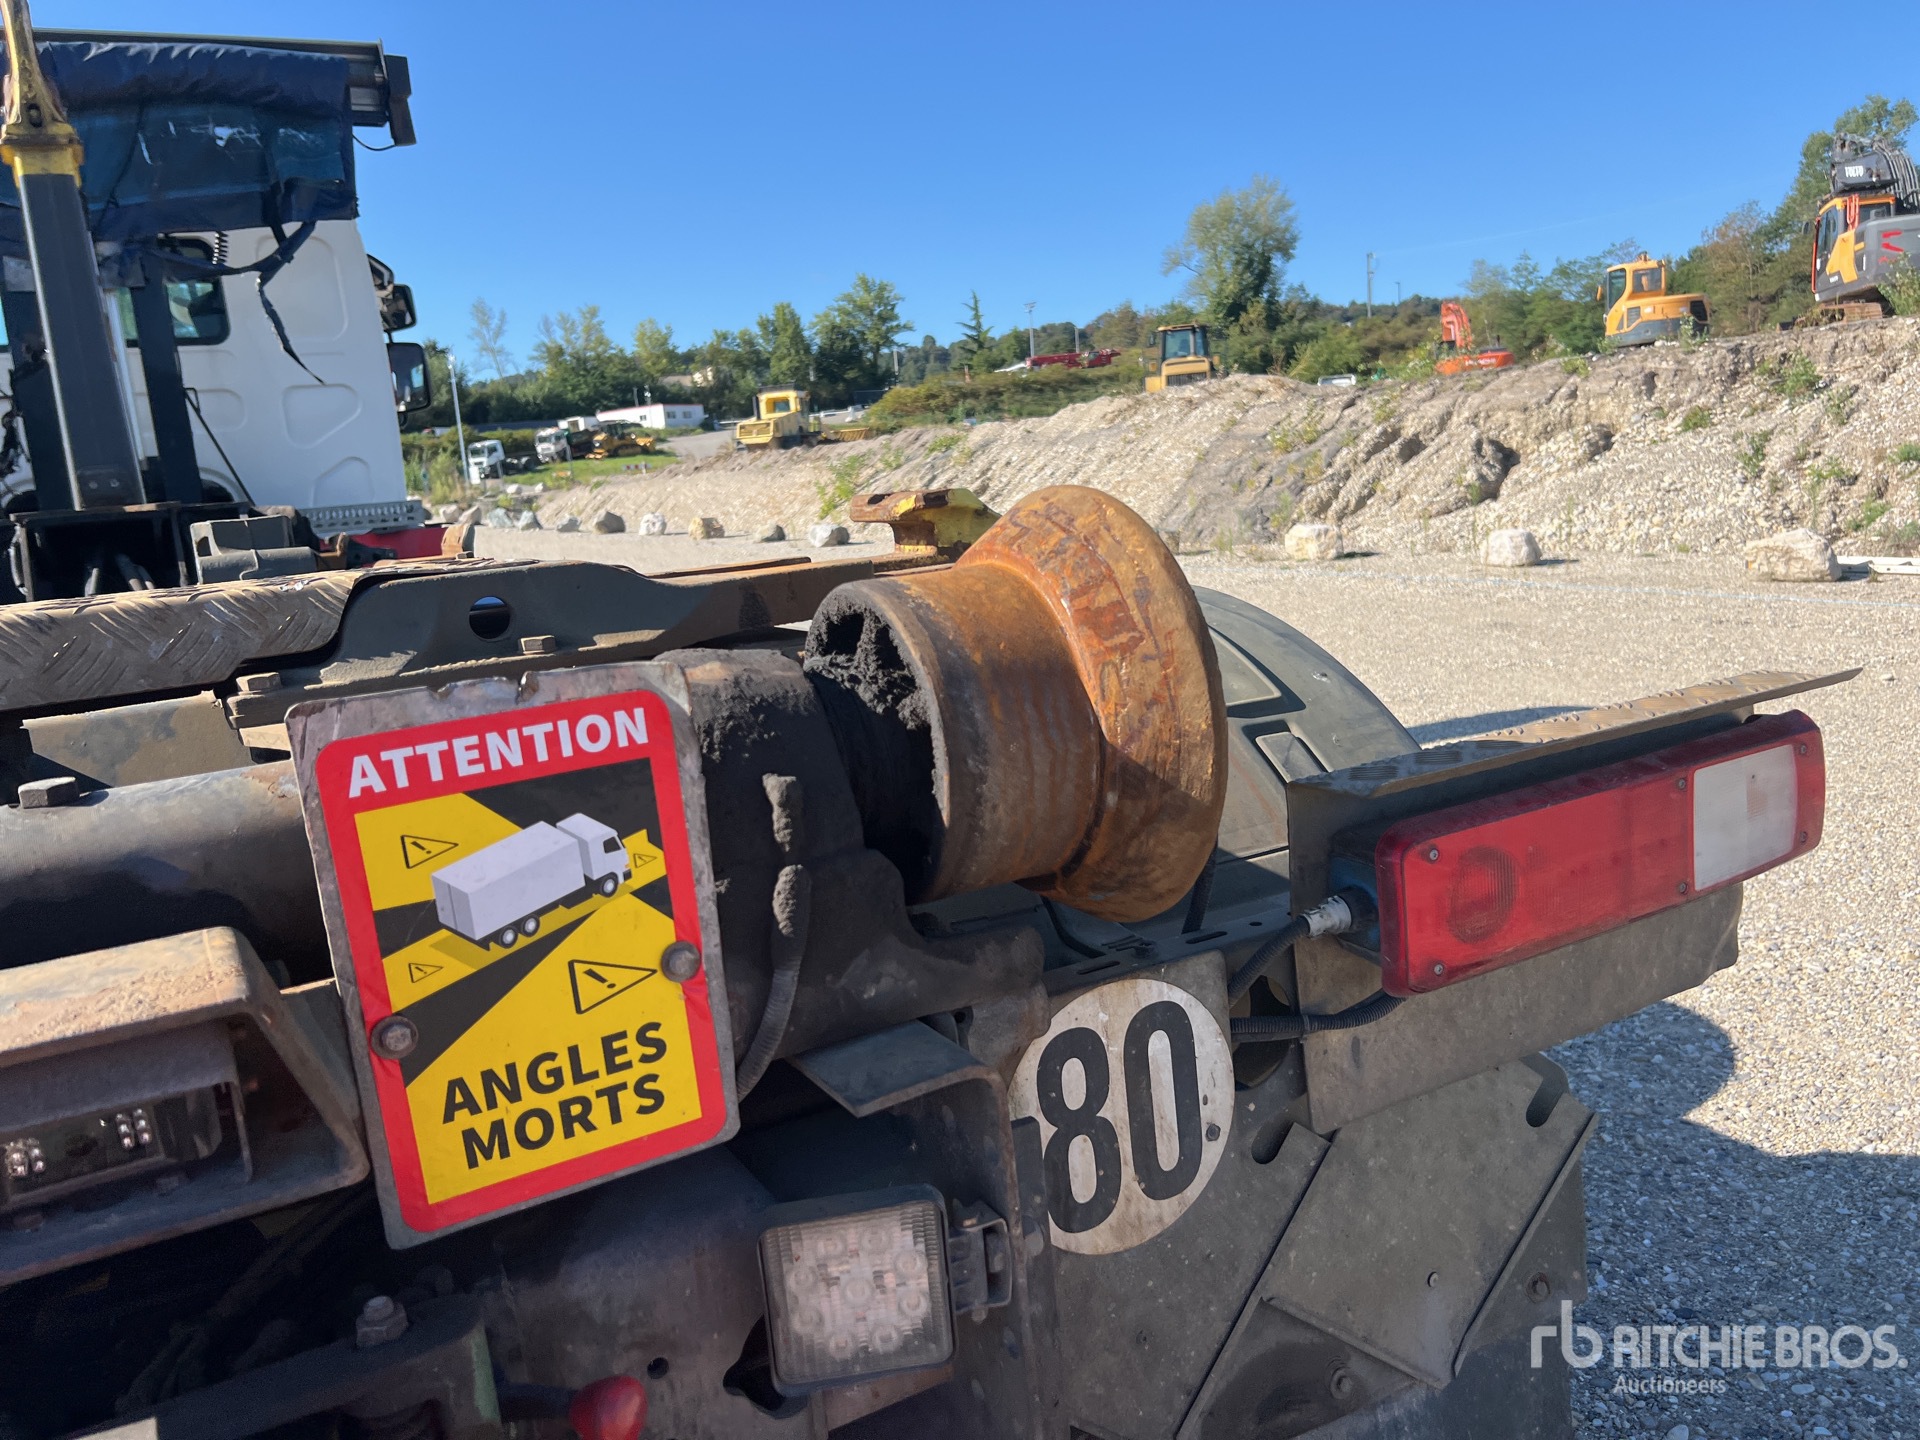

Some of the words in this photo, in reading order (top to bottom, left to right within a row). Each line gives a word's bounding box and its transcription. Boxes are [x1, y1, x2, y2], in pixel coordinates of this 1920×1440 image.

[349, 707, 649, 798] ATTENTION
[442, 1021, 668, 1124] ANGLES
[461, 1074, 666, 1169] MORTS
[1037, 1000, 1203, 1234] 80
